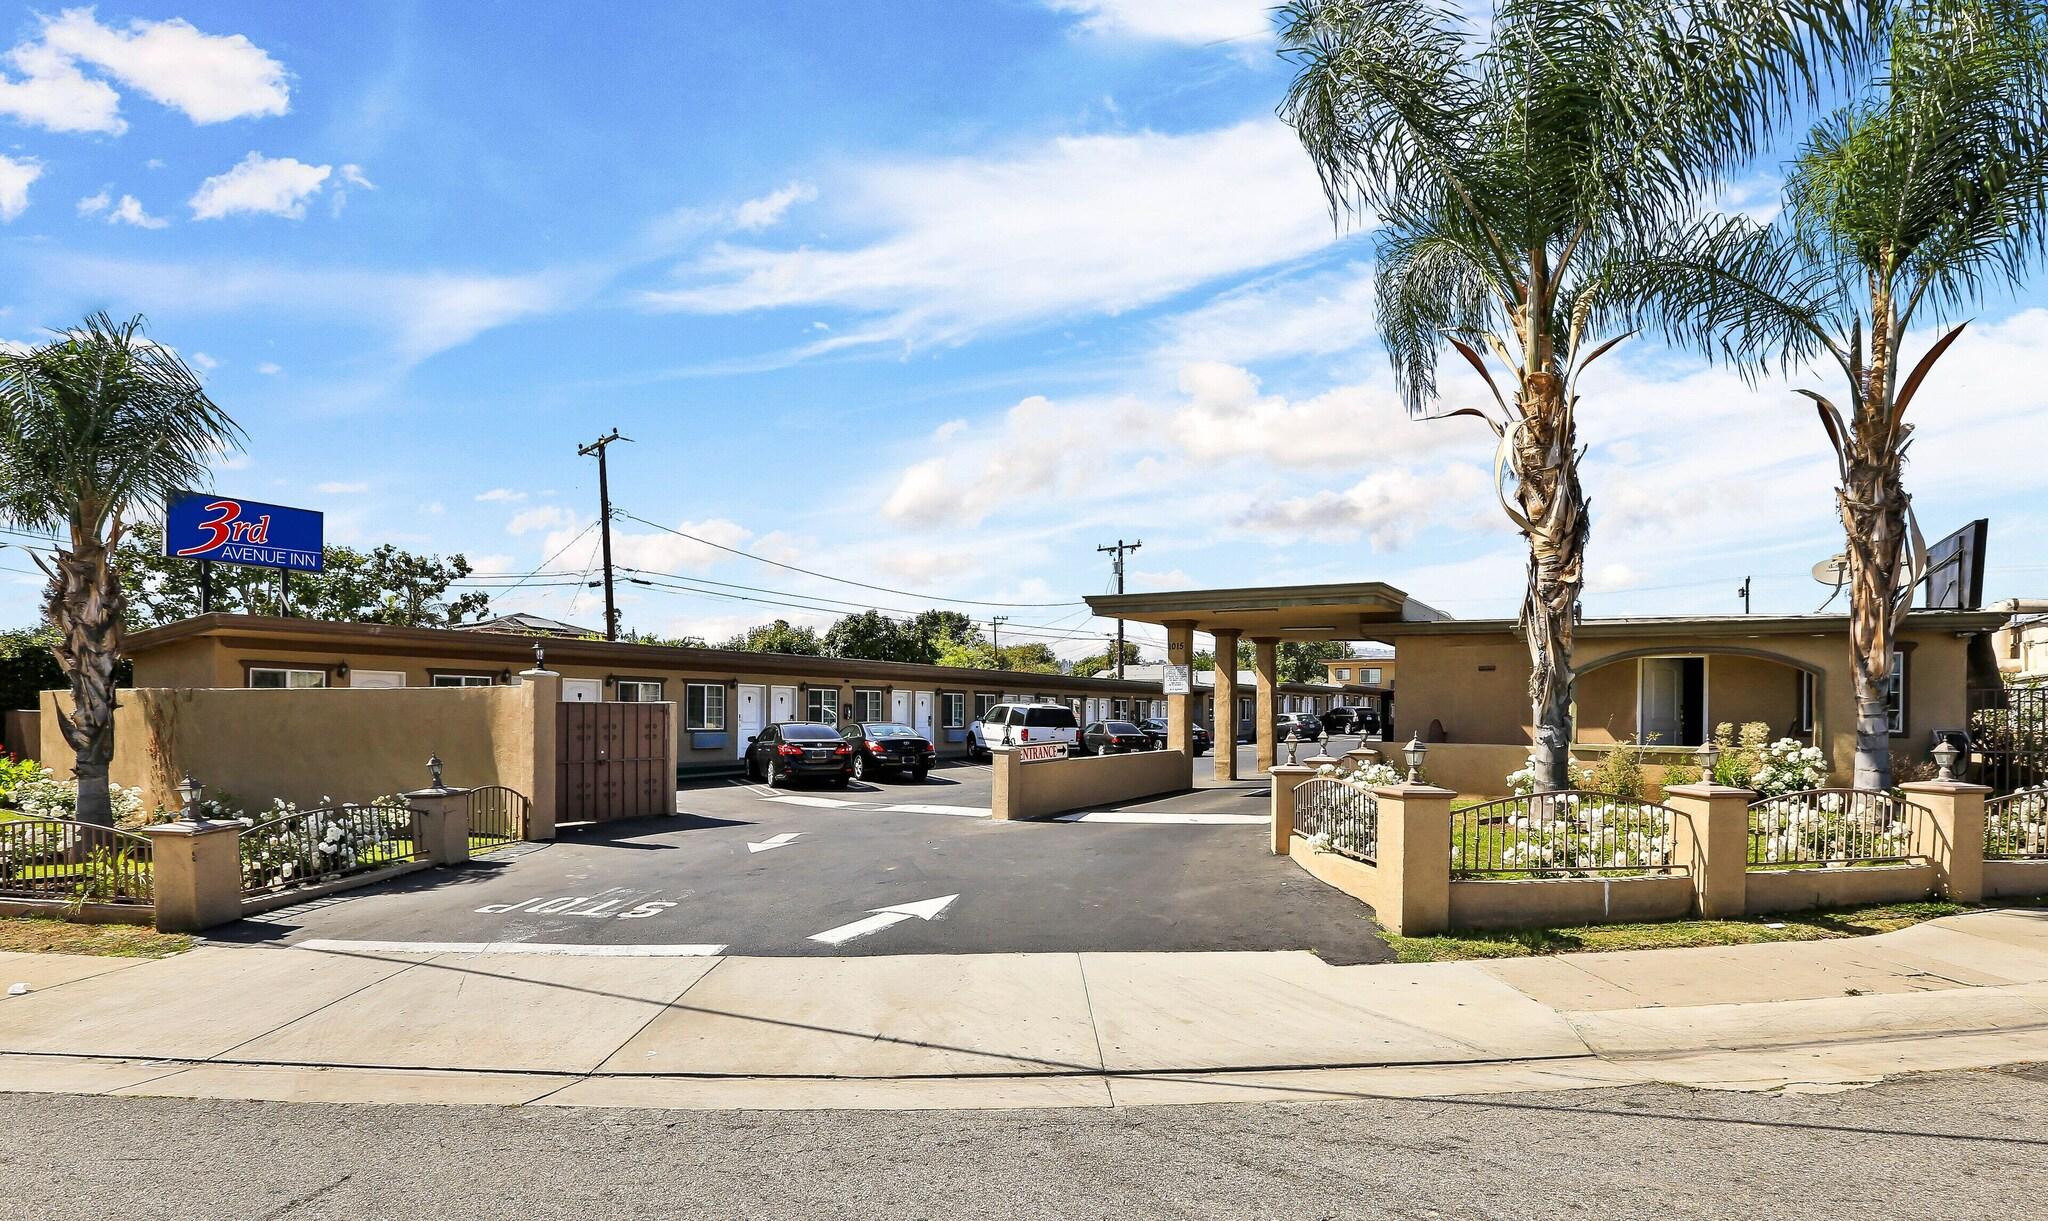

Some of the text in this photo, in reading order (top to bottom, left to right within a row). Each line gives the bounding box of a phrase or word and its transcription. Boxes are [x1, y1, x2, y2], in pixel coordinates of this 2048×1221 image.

[177, 500, 270, 556] 3rd
[221, 546, 316, 567] AVENUE INN
[474, 896, 679, 919] STOP
